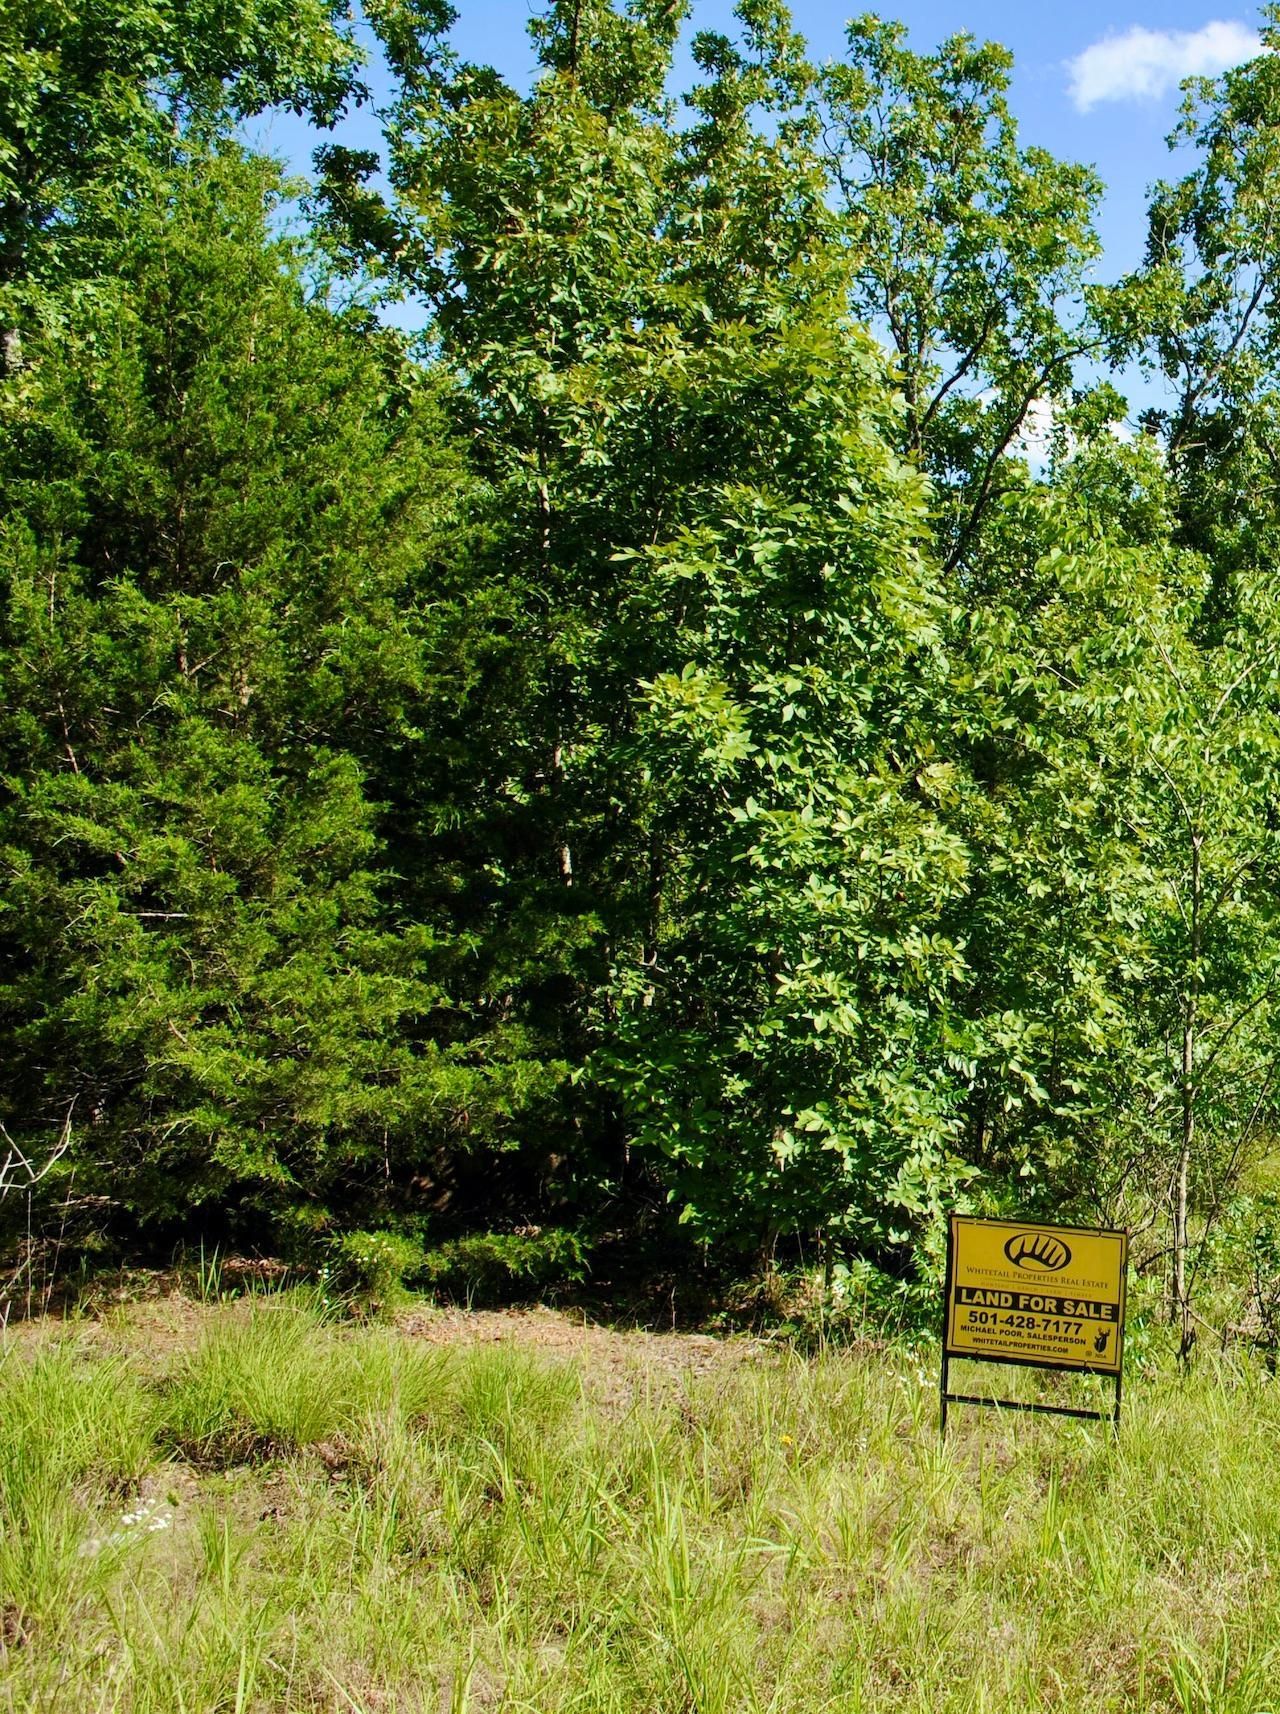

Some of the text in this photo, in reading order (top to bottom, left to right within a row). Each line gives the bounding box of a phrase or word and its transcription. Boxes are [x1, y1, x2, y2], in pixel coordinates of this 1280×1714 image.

[966, 1266, 1109, 1289] WHITETAIL PROPERTIES REAL ESTATE
[961, 1289, 1013, 1308] LAND
[1018, 1295, 1057, 1314] FOR
[1063, 1301, 1113, 1319] SALE
[960, 1325, 1087, 1345] MICHAEL POOR, SALESPERSON
[968, 1311, 1083, 1336] 501-428-7177
[972, 1337, 1069, 1354] WHITETAILPROPERTIES.COM
